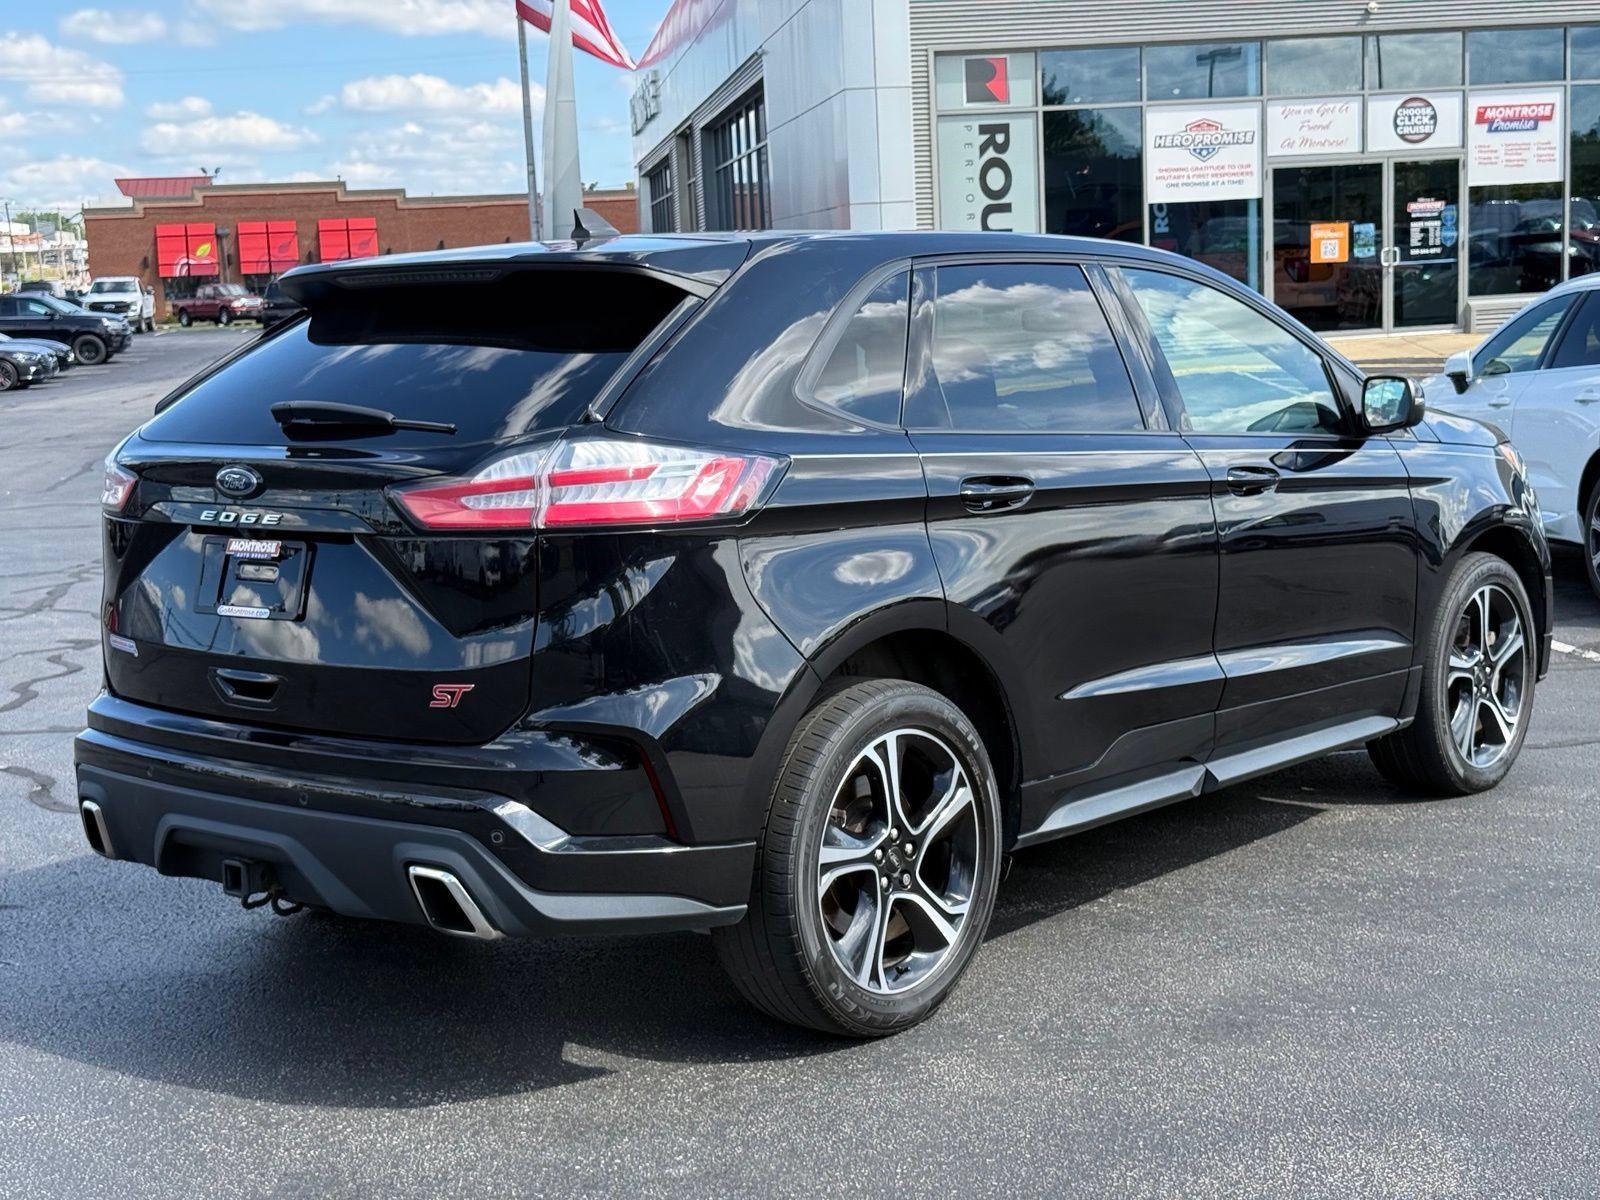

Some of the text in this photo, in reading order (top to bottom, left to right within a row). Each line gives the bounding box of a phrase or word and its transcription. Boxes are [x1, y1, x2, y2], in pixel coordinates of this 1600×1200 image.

[1484, 104, 1553, 119] MONTROSE
[1154, 130, 1255, 148] HERO PROMISE
[1190, 165, 1226, 173] GRATITUDE
[1211, 171, 1254, 179] RESPONDERS
[1181, 180, 1210, 188] PROMISE
[223, 473, 246, 490] Ford
[200, 510, 283, 525] EDGE
[229, 540, 278, 553] MONTROSE
[219, 605, 269, 617] GoMontrose.com
[429, 683, 475, 708] ST
